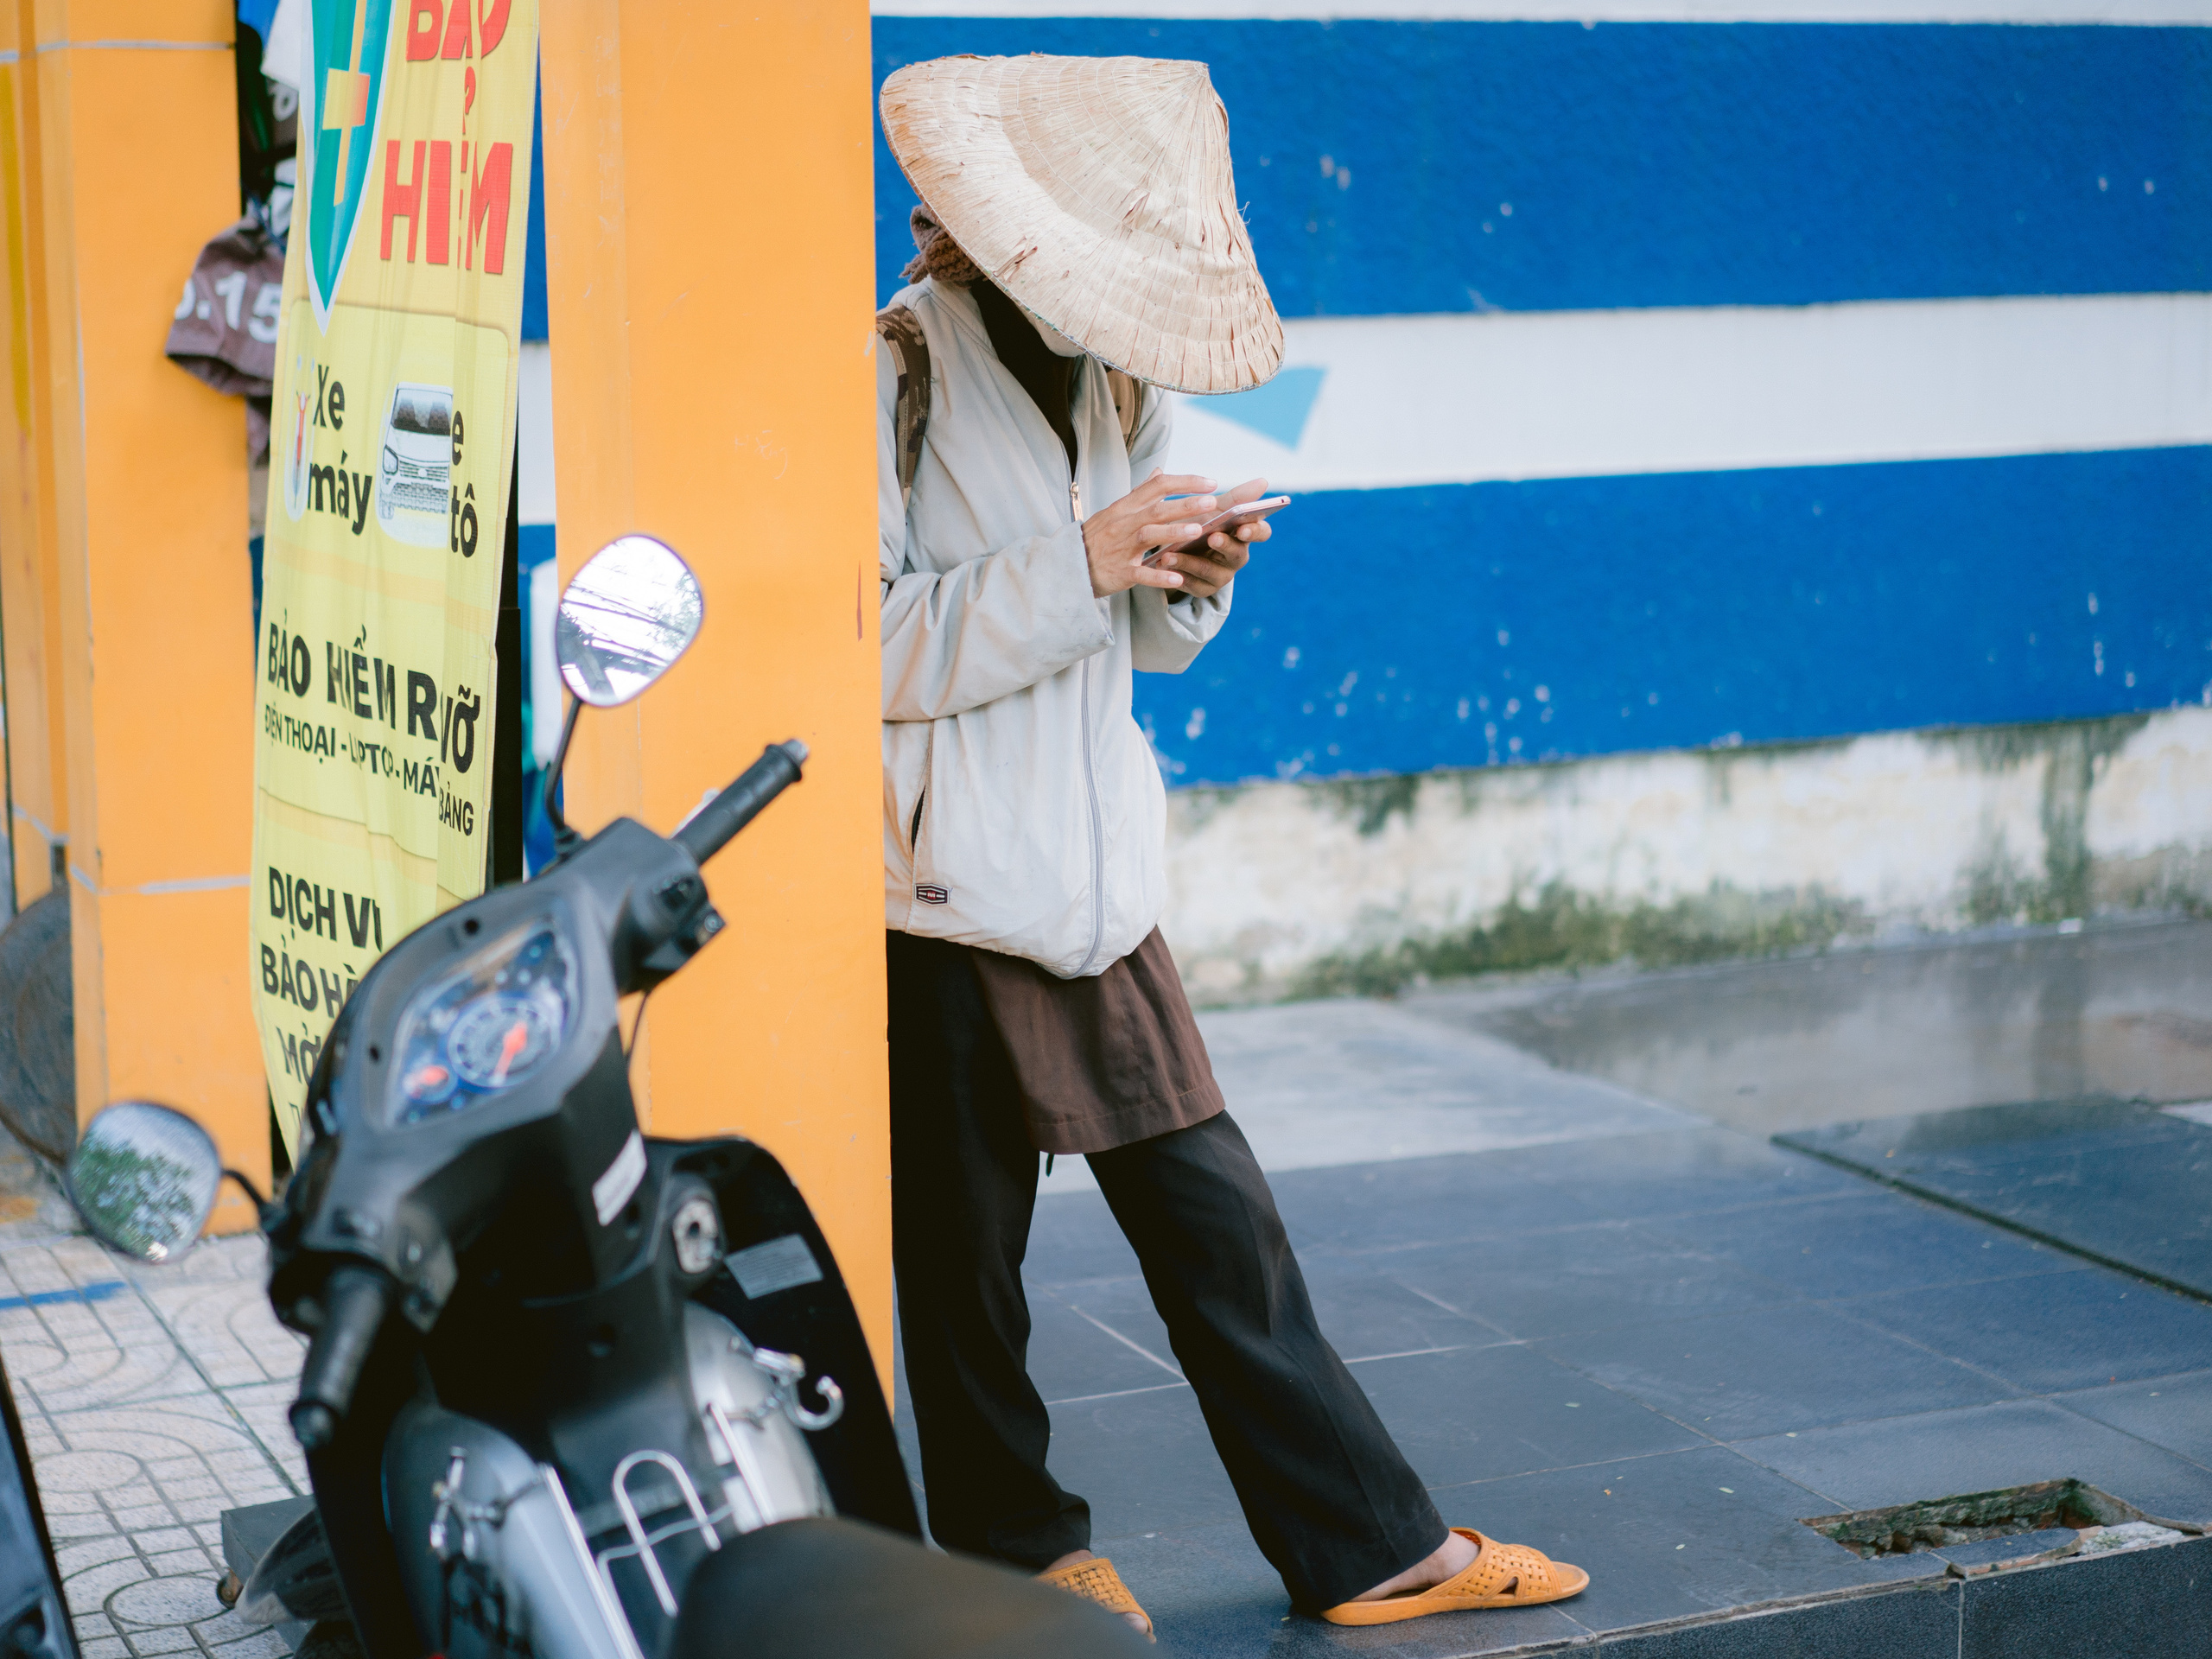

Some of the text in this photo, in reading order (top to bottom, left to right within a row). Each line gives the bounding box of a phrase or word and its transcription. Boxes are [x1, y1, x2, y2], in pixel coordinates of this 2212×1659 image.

[313, 364, 346, 431] Xe
[308, 449, 372, 537] máy
[284, 715, 336, 764] THOẠI
[269, 866, 338, 942] DỊCH
[261, 933, 319, 1012] BẢO
